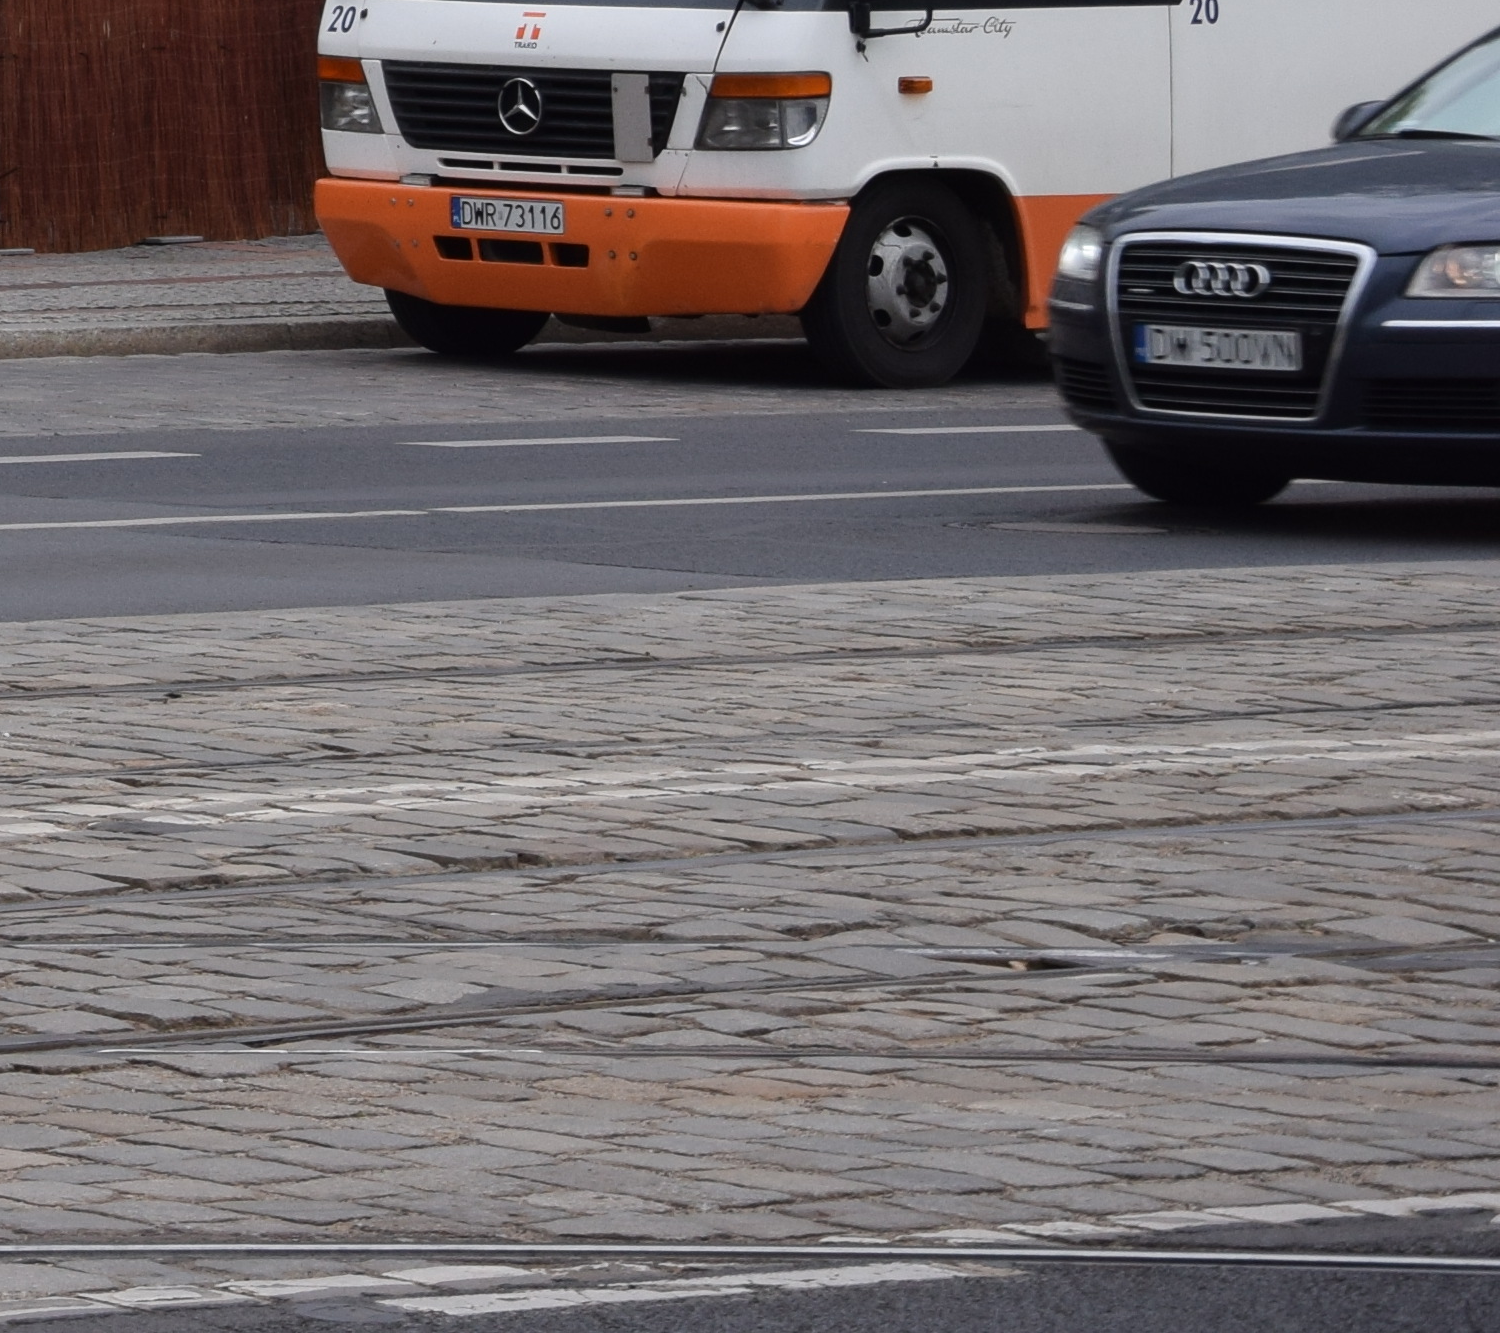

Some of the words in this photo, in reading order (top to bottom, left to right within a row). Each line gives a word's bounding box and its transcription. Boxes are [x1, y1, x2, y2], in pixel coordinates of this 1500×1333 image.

[327, 5, 357, 33] 20
[461, 200, 497, 228] DWR
[503, 203, 561, 230] 73116
